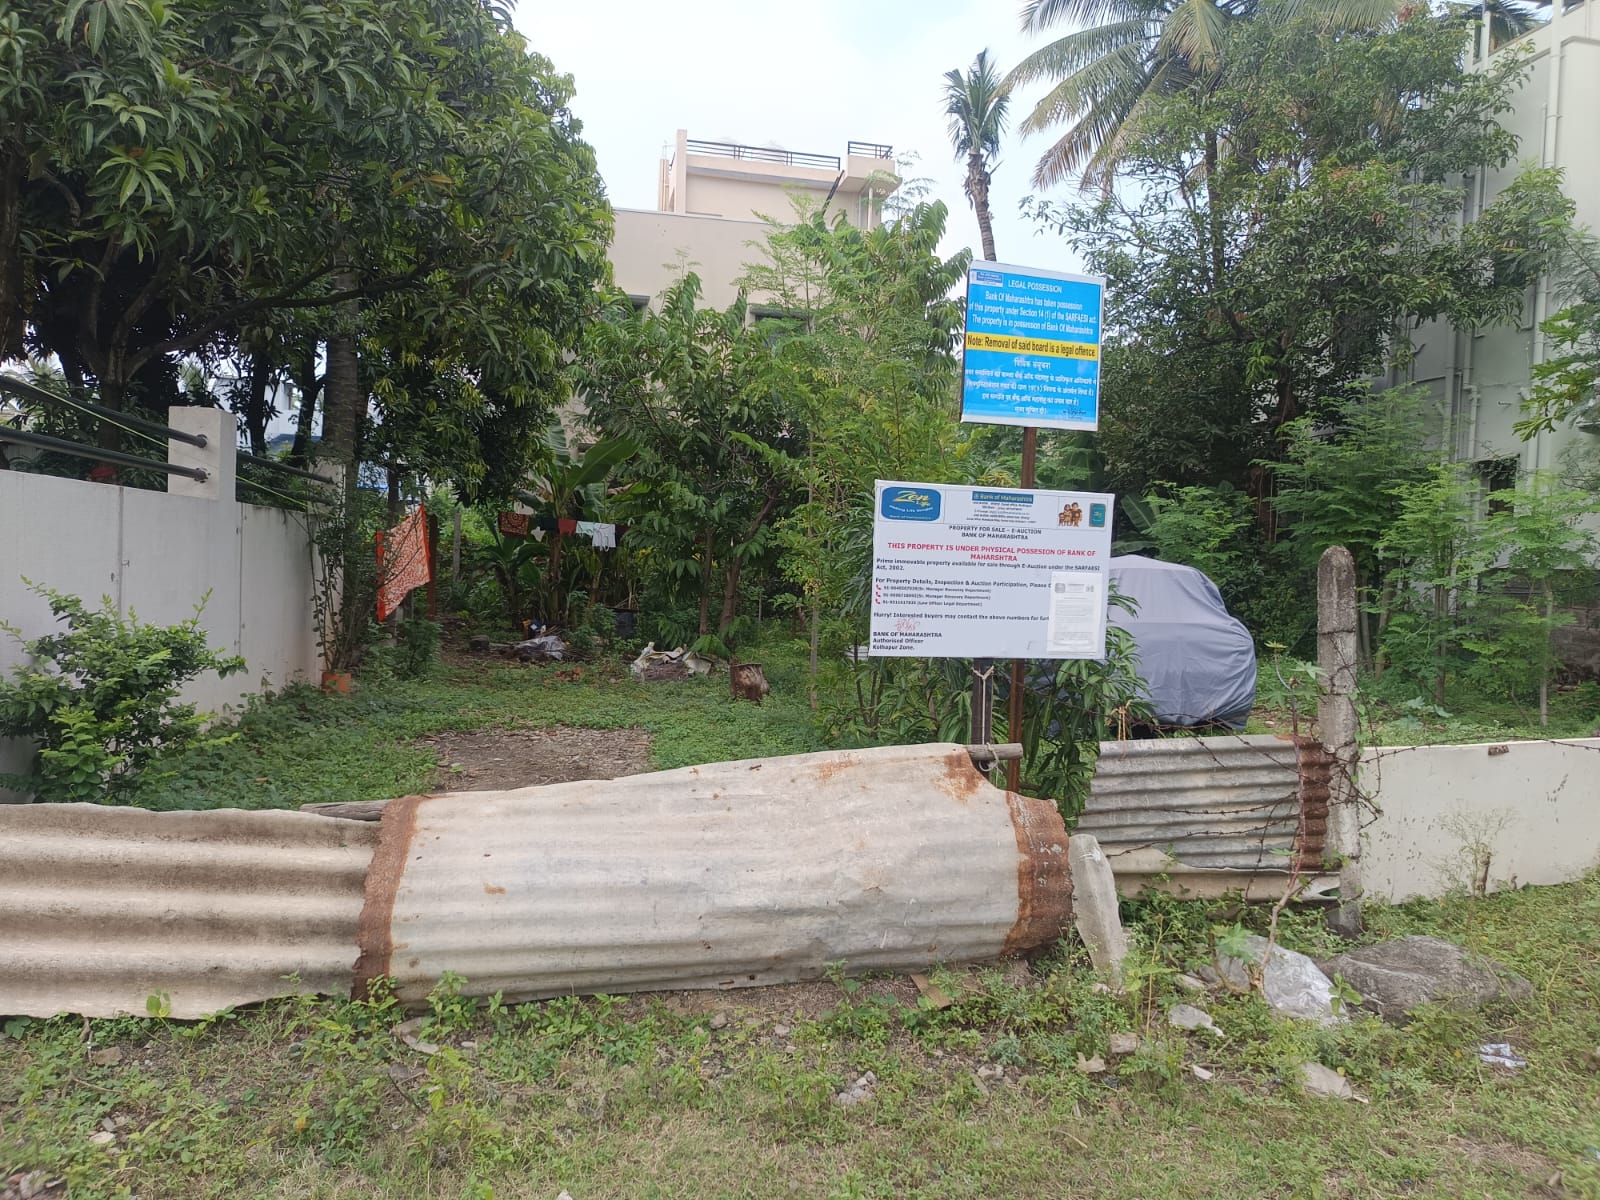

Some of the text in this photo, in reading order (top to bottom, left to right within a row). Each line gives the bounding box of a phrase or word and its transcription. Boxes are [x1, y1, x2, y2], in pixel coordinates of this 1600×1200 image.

[1008, 280, 1062, 293] LEGAL POSSESSION
[985, 290, 998, 300] Bank
[998, 292, 1005, 300] Of
[1005, 292, 1034, 304] Maharashtra
[975, 303, 984, 312] this
[985, 305, 1004, 316] property
[1005, 306, 1019, 315] under
[1020, 307, 1037, 317] Section
[1051, 311, 1057, 319] of
[972, 314, 981, 323] The
[982, 316, 1002, 327] property
[1003, 318, 1007, 326] is
[1014, 321, 1040, 330] possession
[1041, 322, 1046, 330] of
[1047, 322, 1058, 331] Bank
[1059, 323, 1065, 332] Of
[967, 335, 983, 346] Note:
[985, 337, 1010, 348] Removal
[1011, 339, 1018, 348] of
[1018, 340, 1031, 350] said
[1032, 341, 1048, 352] board
[1049, 343, 1055, 353] is
[1061, 344, 1073, 356] legal
[1075, 346, 1095, 357] offence
